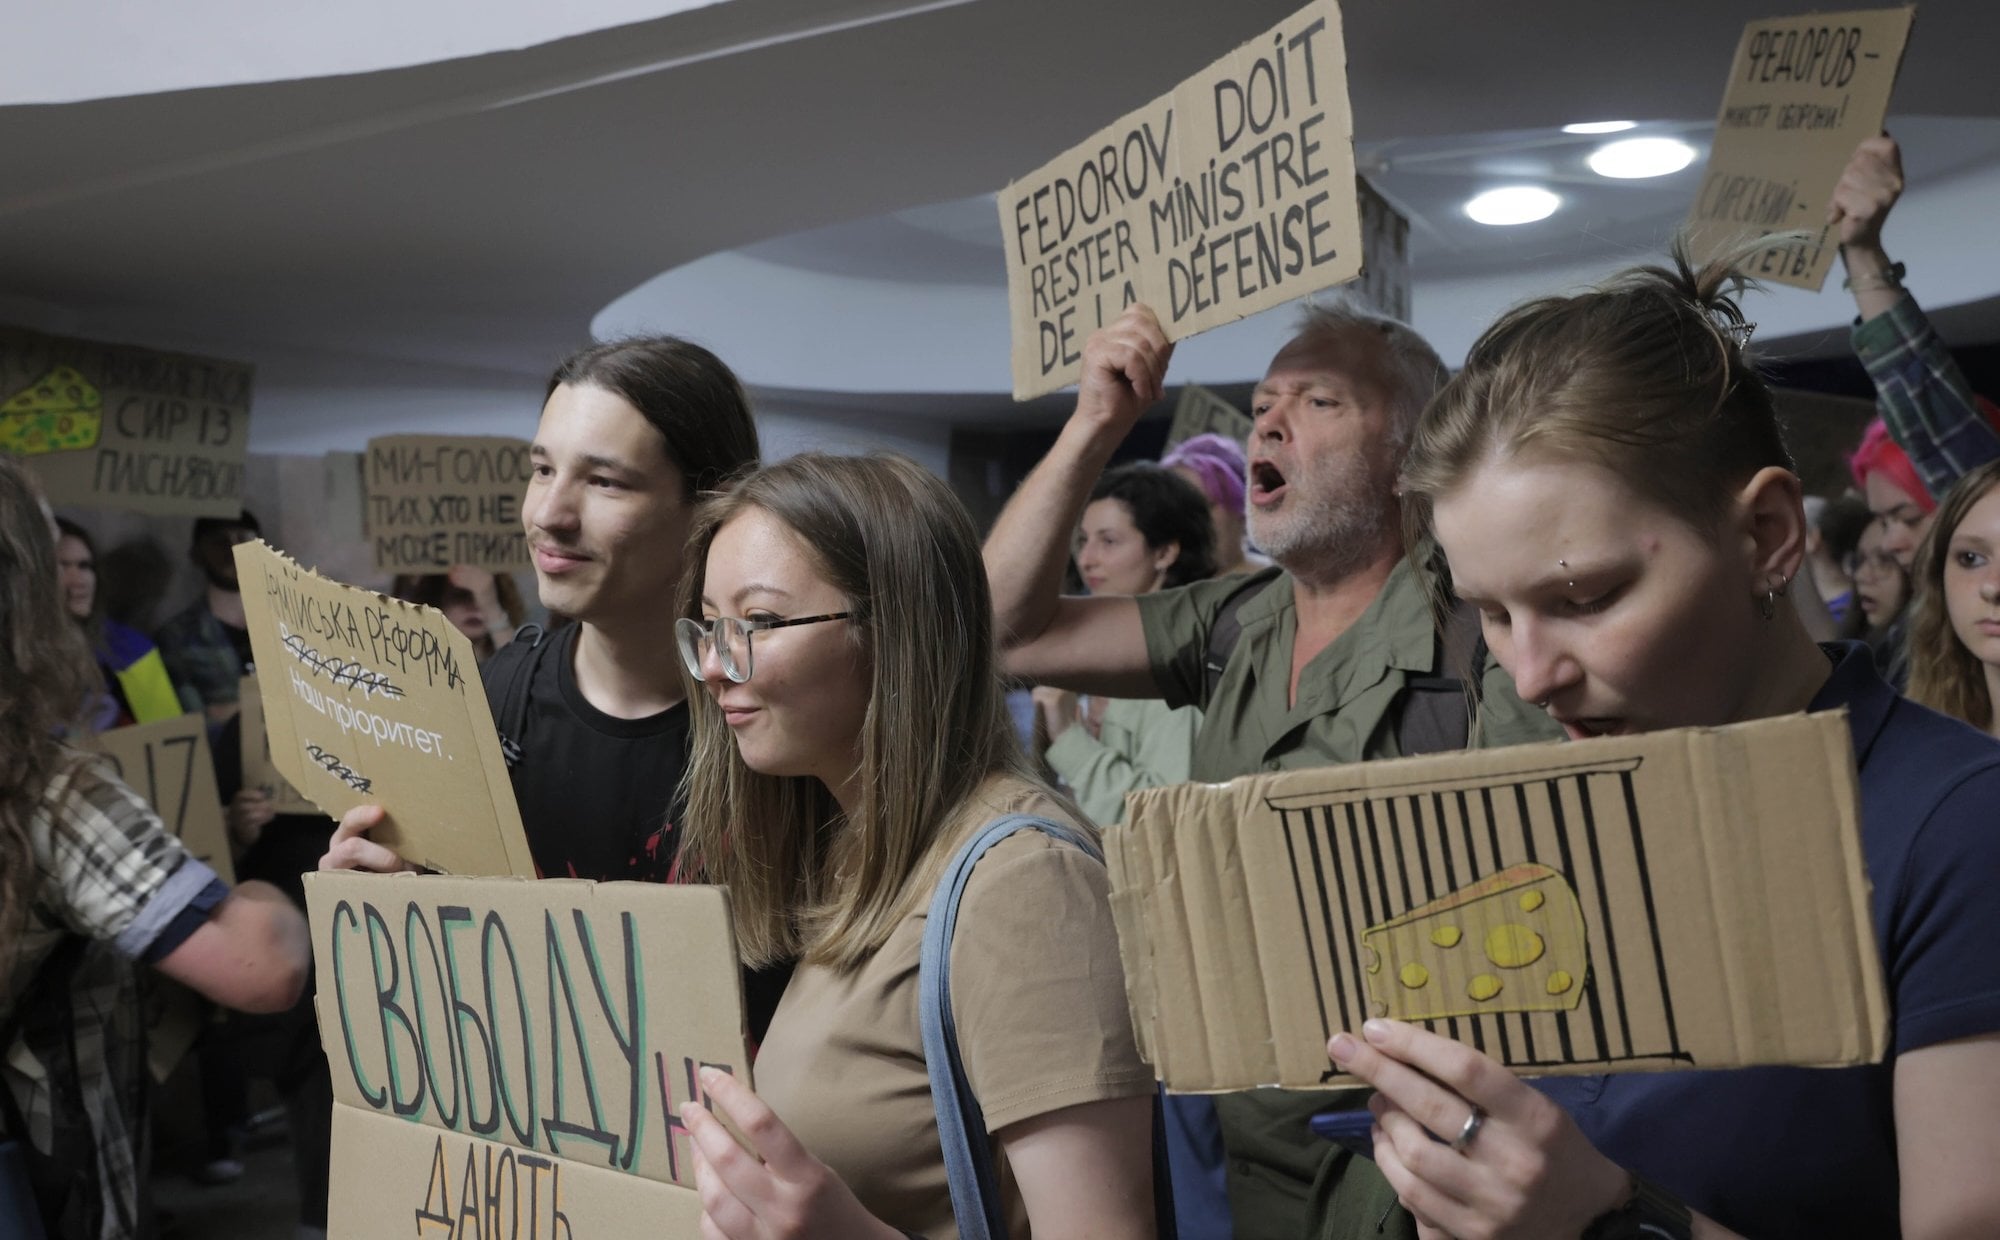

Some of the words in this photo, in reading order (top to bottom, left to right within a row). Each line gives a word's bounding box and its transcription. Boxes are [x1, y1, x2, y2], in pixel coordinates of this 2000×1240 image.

[1747, 26, 1862, 88] ФЕДОРОВ
[1016, 109, 1173, 266] FEDOROV
[1031, 221, 1139, 318] RESTER
[1040, 306, 1082, 376] DE
[1167, 191, 1337, 324] DÉFENSE
[115, 395, 190, 441] СИР
[376, 533, 450, 567] МОЖЕ
[478, 494, 517, 525] НЕ
[364, 606, 466, 691] РЕФОРМА
[288, 664, 326, 715] Наш
[325, 697, 454, 762] пріоритет.
[331, 900, 646, 1174] СВОБОДУ
